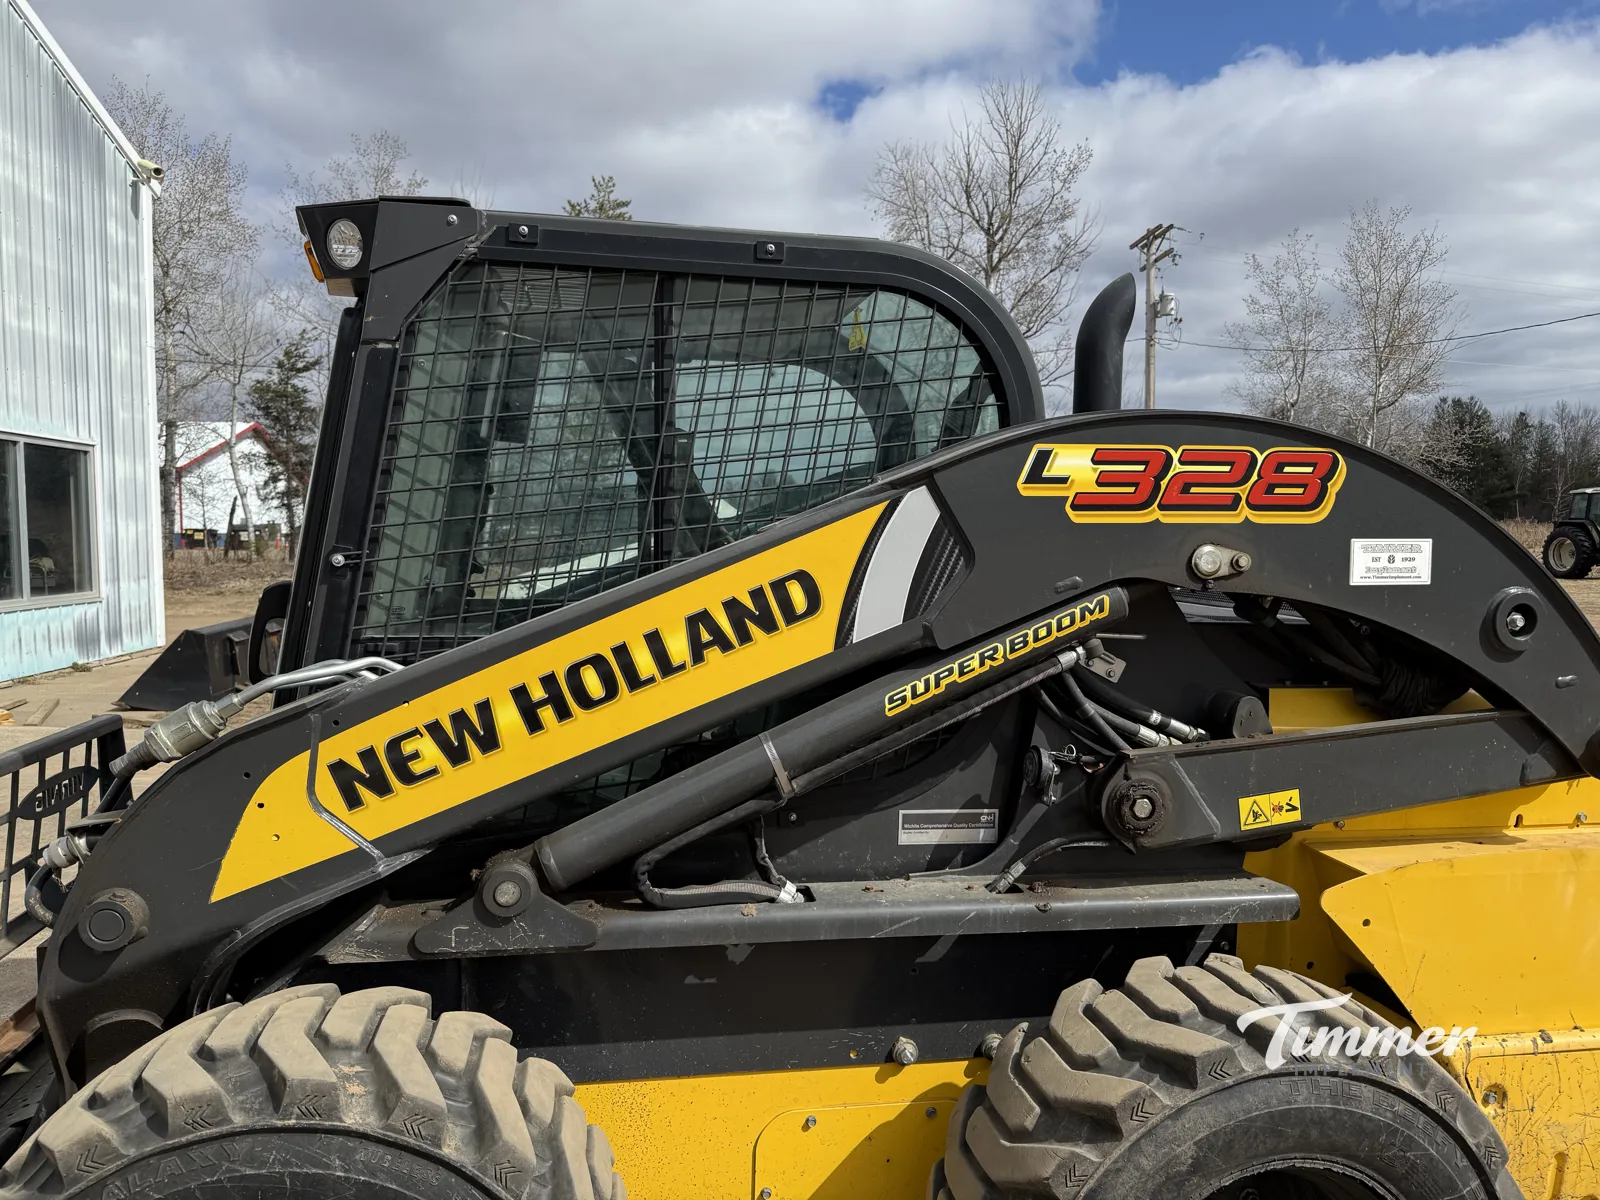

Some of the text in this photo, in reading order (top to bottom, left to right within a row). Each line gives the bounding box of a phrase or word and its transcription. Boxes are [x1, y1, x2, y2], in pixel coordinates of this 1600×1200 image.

[1017, 443, 1347, 524] L328
[1361, 544, 1423, 554] TIMMER
[1364, 566, 1417, 575] Implement
[885, 594, 1110, 717] SUPER BOOM
[326, 568, 823, 814] NEW HOLLAND
[1280, 1078, 1364, 1101] THE
